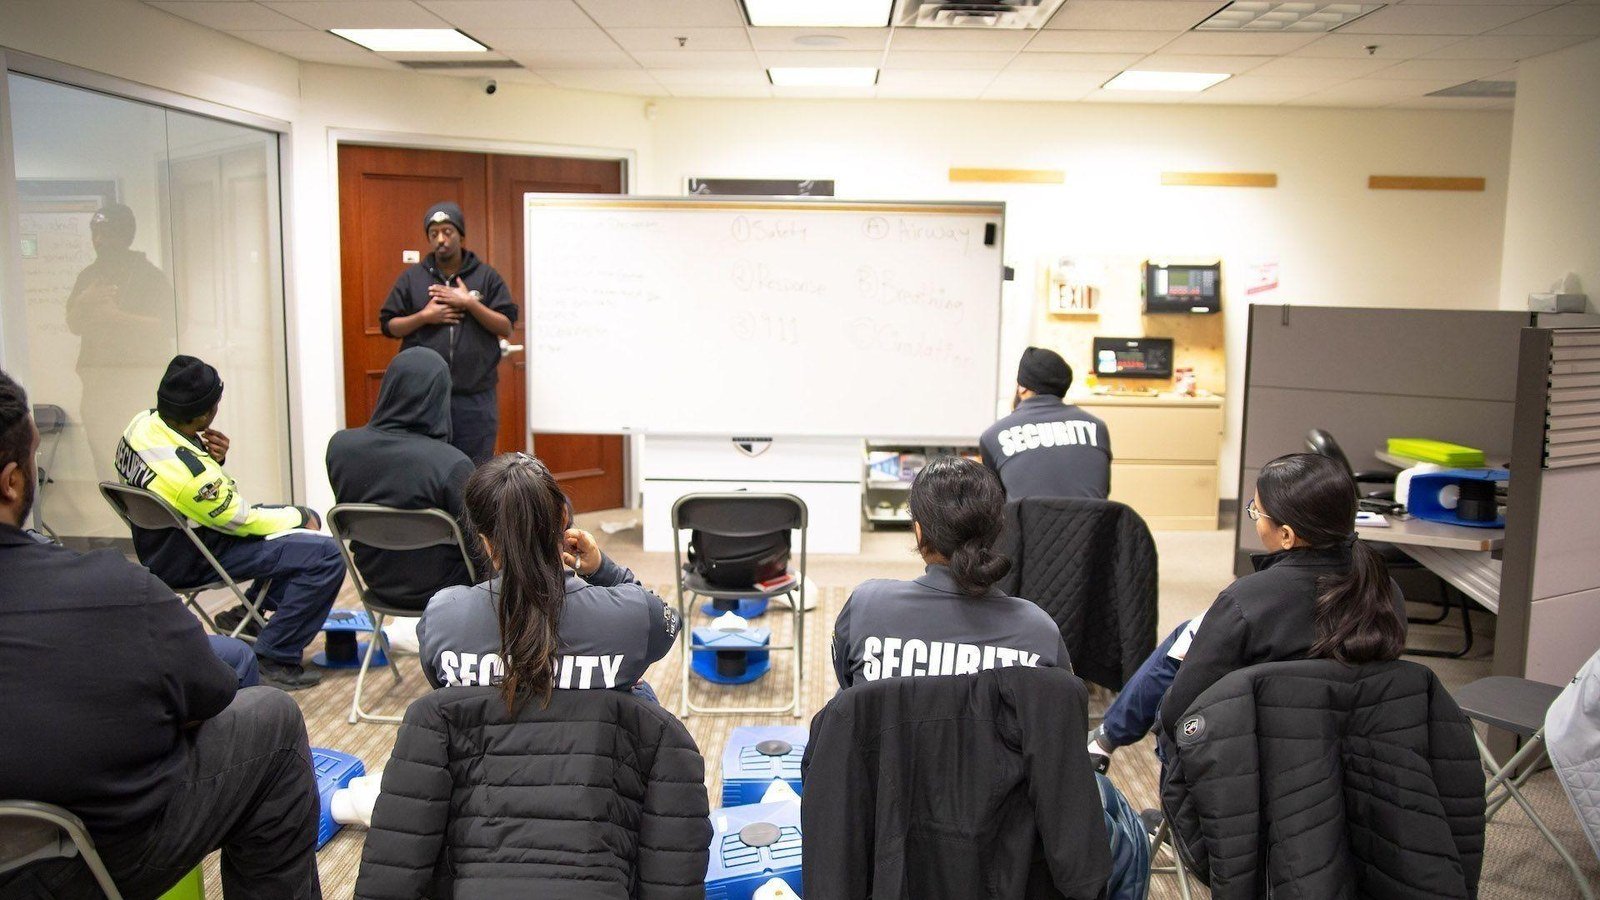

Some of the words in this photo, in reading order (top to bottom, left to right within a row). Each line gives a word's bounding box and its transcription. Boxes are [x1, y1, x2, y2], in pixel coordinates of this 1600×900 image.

[898, 218, 970, 256] Airway
[1059, 284, 1094, 309] EXIT
[998, 420, 1097, 456] SECURITY
[115, 437, 155, 488] SECURITY
[440, 650, 624, 690] SECITY
